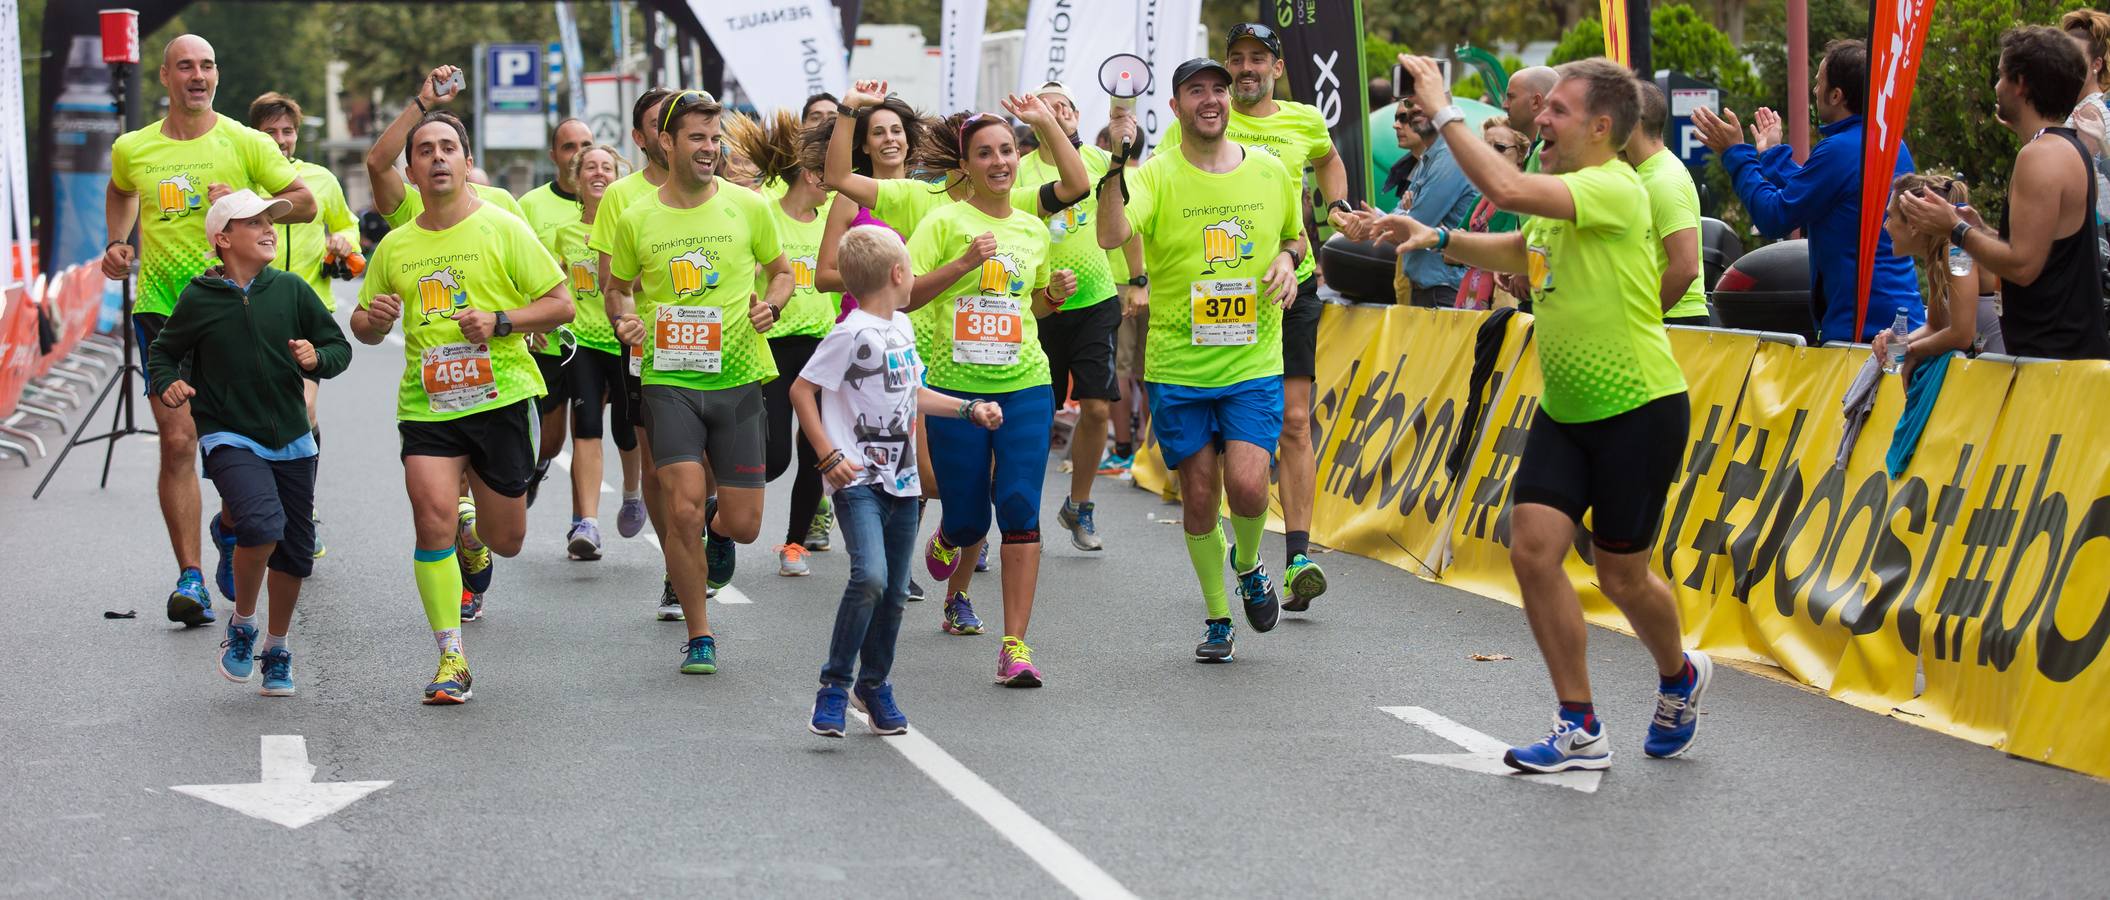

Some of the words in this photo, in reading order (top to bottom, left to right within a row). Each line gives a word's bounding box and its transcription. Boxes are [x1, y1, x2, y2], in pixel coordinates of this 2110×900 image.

[498, 53, 531, 86] P
[1225, 131, 1293, 145] rinkingrunners
[145, 161, 214, 174] Drinkingrunners
[1182, 202, 1264, 218] Drinkingrunners
[651, 234, 733, 254] Drinkingrunners
[401, 253, 479, 273] Drinkingrunners
[1205, 297, 1246, 317] 370
[666, 323, 710, 345] 382
[967, 314, 1012, 336] 380
[435, 359, 480, 384] 464
